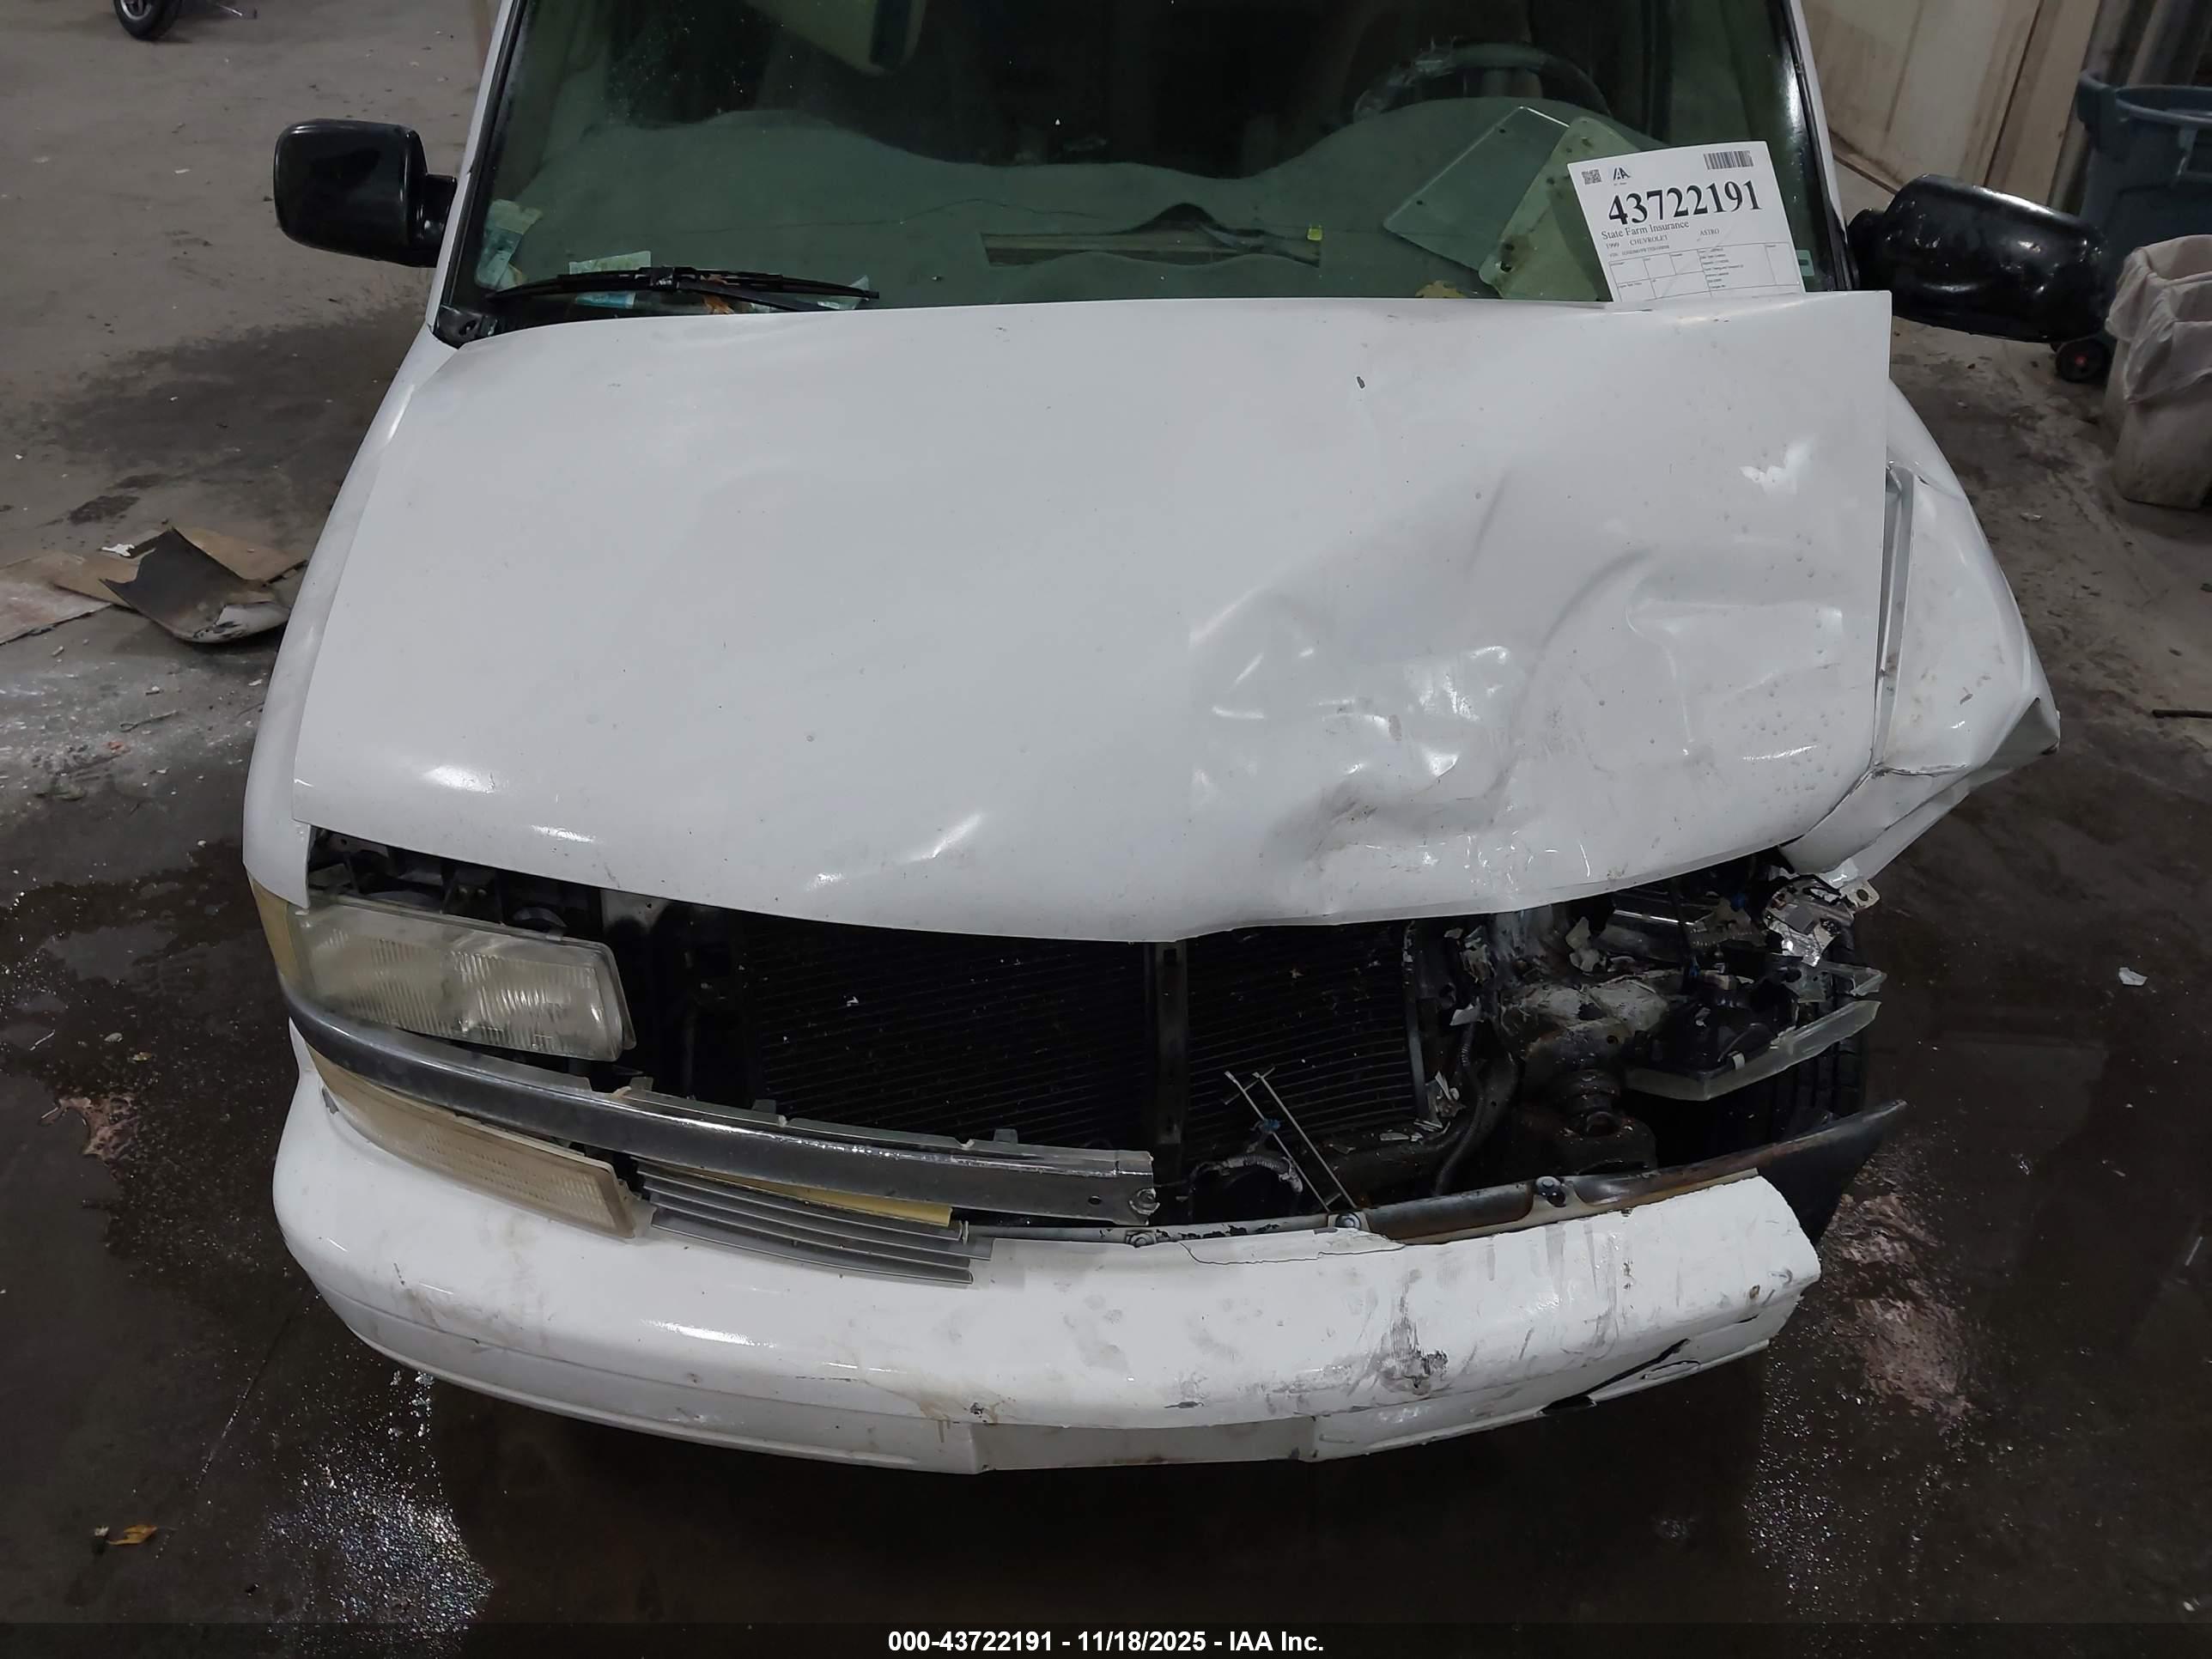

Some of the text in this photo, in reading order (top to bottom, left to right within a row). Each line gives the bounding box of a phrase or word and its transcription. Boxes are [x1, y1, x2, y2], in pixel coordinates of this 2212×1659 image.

[1608, 179, 1762, 225] 43722191
[1601, 221, 1690, 240] State Farm Insurance
[1629, 234, 1668, 246] CHEVROLET
[1700, 228, 1720, 236] ASTRO
